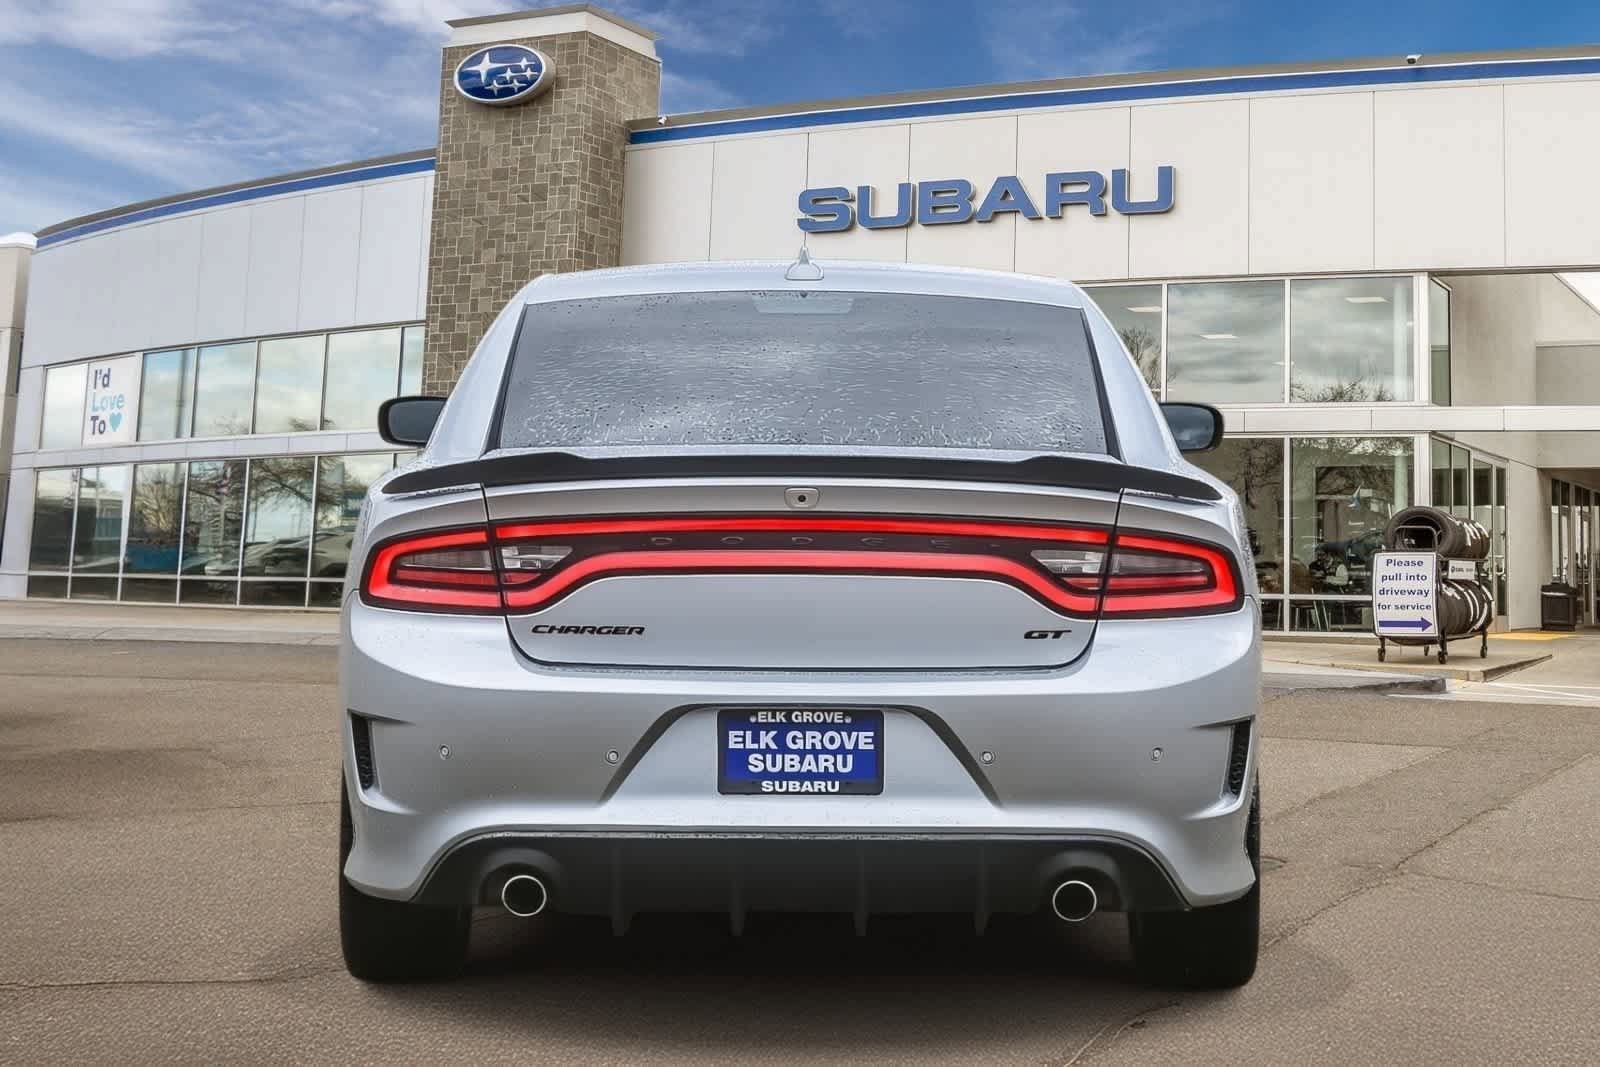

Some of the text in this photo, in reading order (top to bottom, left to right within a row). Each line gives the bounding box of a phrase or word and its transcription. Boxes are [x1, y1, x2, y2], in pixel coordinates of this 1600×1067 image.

[797, 165, 1176, 233] SUBARU
[93, 368, 111, 390] I'd
[91, 392, 125, 412] Love
[90, 415, 106, 435] To
[1386, 558, 1424, 567] Please
[1381, 573, 1428, 583] pull into
[1378, 587, 1430, 597] driveway
[1377, 602, 1432, 611] for service
[531, 624, 646, 636] CHARGER
[1023, 630, 1073, 640] GT
[757, 711, 844, 723] ELK GROVE
[728, 730, 875, 750] ELK GROVE
[747, 753, 853, 773] SUBARU
[761, 780, 840, 793] SUBARU
